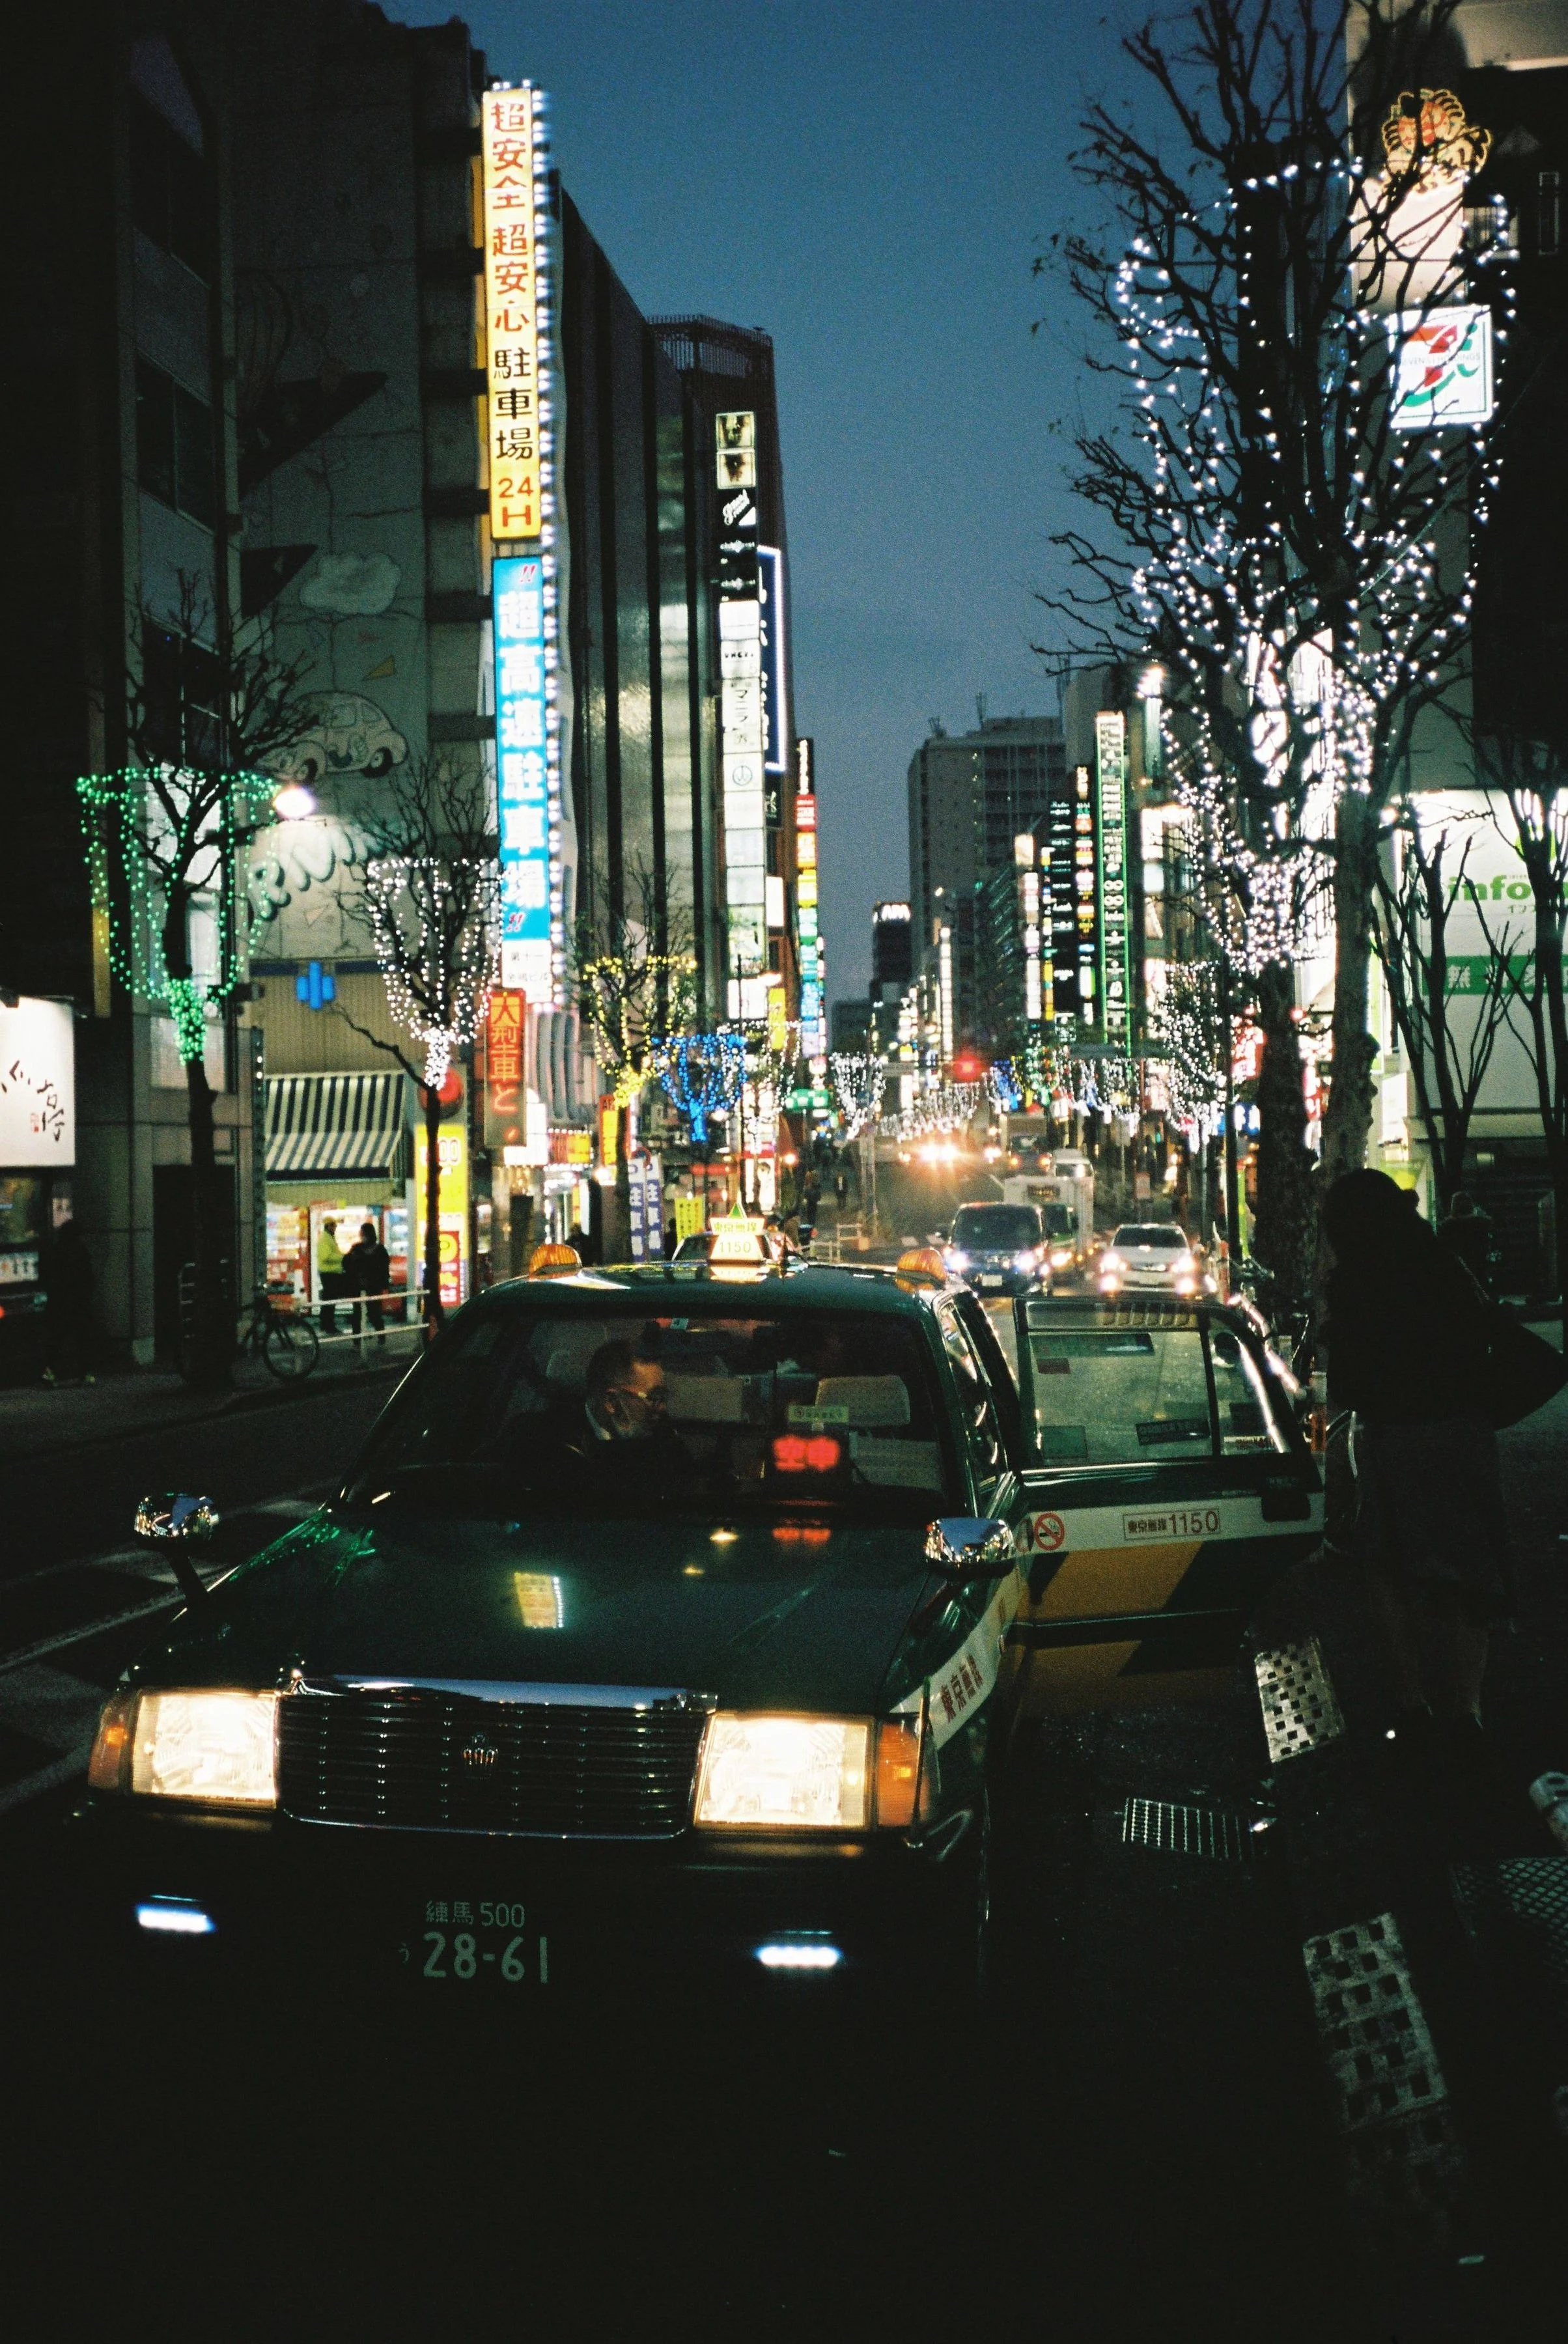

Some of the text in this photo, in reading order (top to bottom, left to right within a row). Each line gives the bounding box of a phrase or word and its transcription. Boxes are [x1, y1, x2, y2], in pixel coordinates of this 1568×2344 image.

[490, 101, 527, 210] 超安全
[492, 223, 531, 333] 超安心
[493, 346, 534, 461] 駐車場
[720, 1241, 751, 1254] 1150
[1169, 1510, 1220, 1535] 1150
[426, 1901, 525, 1928] 練馬 500
[423, 1931, 548, 1983] 28-61
